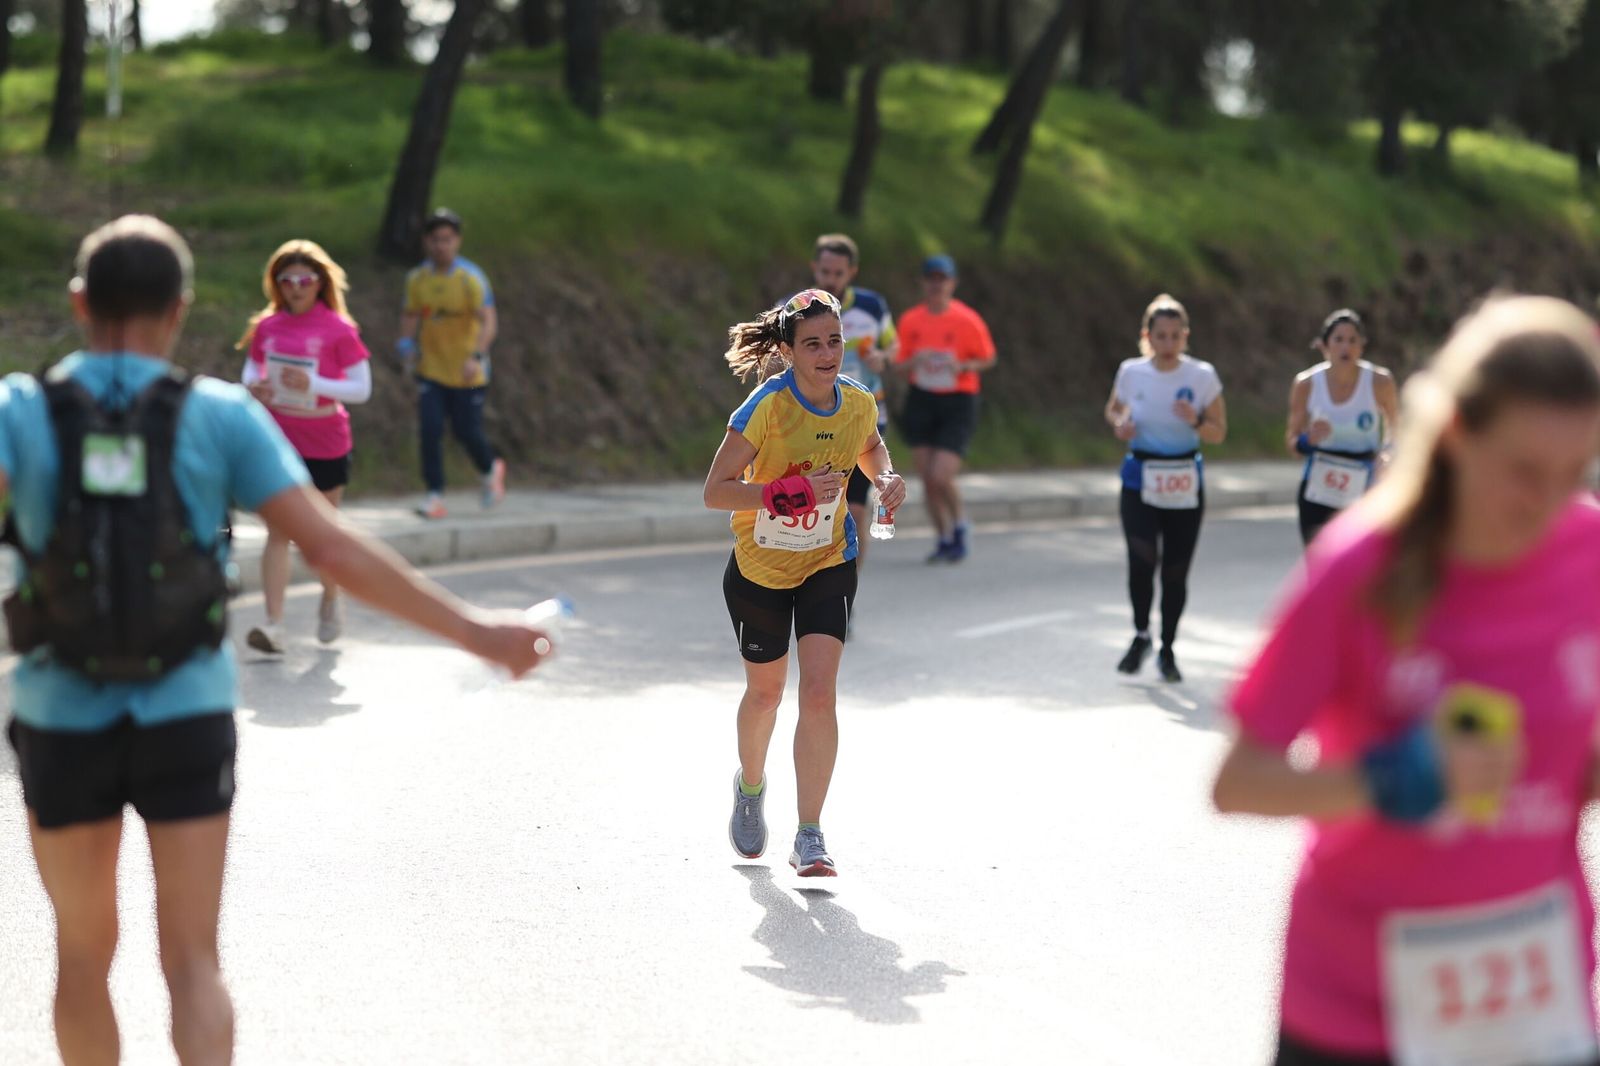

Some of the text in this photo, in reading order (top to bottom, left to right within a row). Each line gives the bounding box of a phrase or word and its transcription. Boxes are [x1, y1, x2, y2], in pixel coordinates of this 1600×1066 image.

[816, 430, 834, 440] vive
[1155, 474, 1190, 494] 100
[1325, 469, 1350, 491] 62
[1428, 943, 1556, 1025] 121
